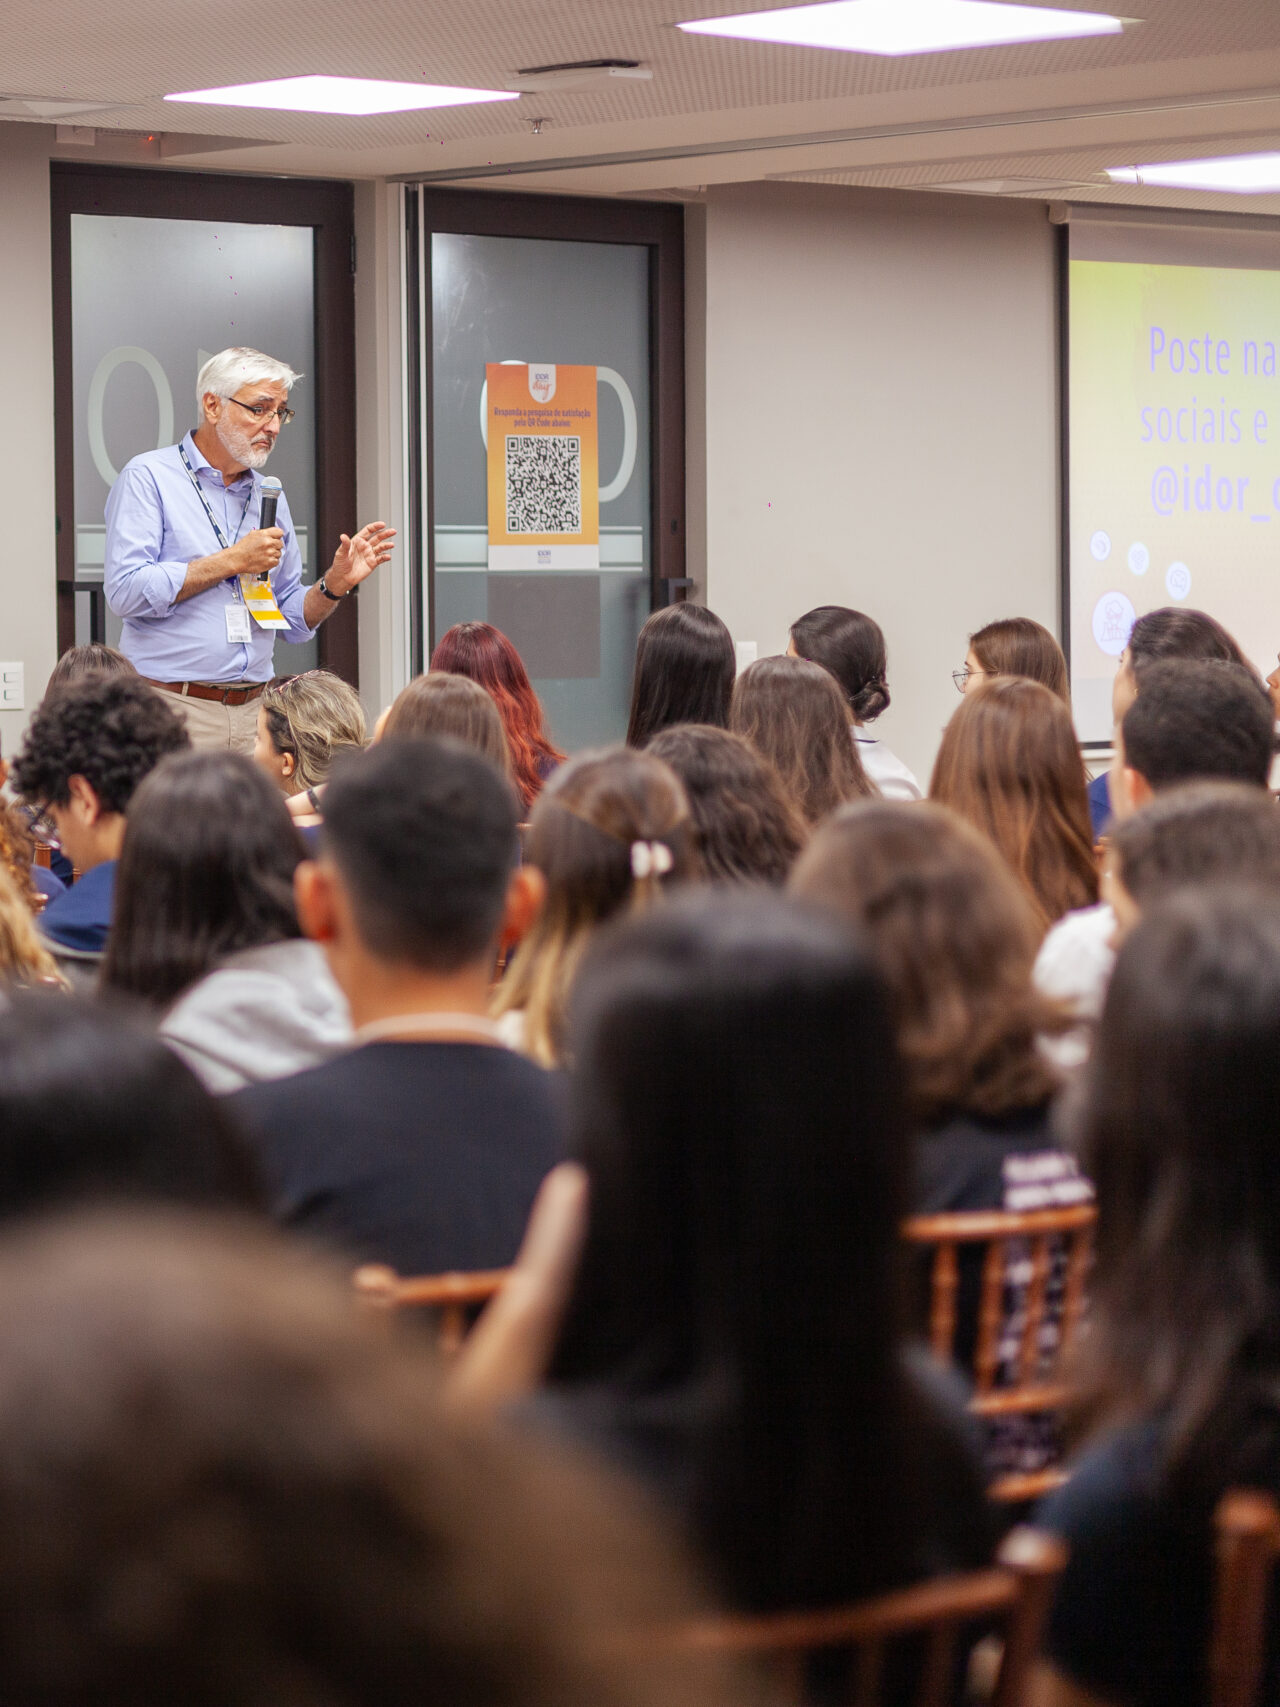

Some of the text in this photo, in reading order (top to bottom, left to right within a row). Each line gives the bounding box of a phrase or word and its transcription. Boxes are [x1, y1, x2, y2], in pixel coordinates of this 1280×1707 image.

[1150, 326, 1280, 376] Poste na
[1140, 395, 1268, 444] sociais e
